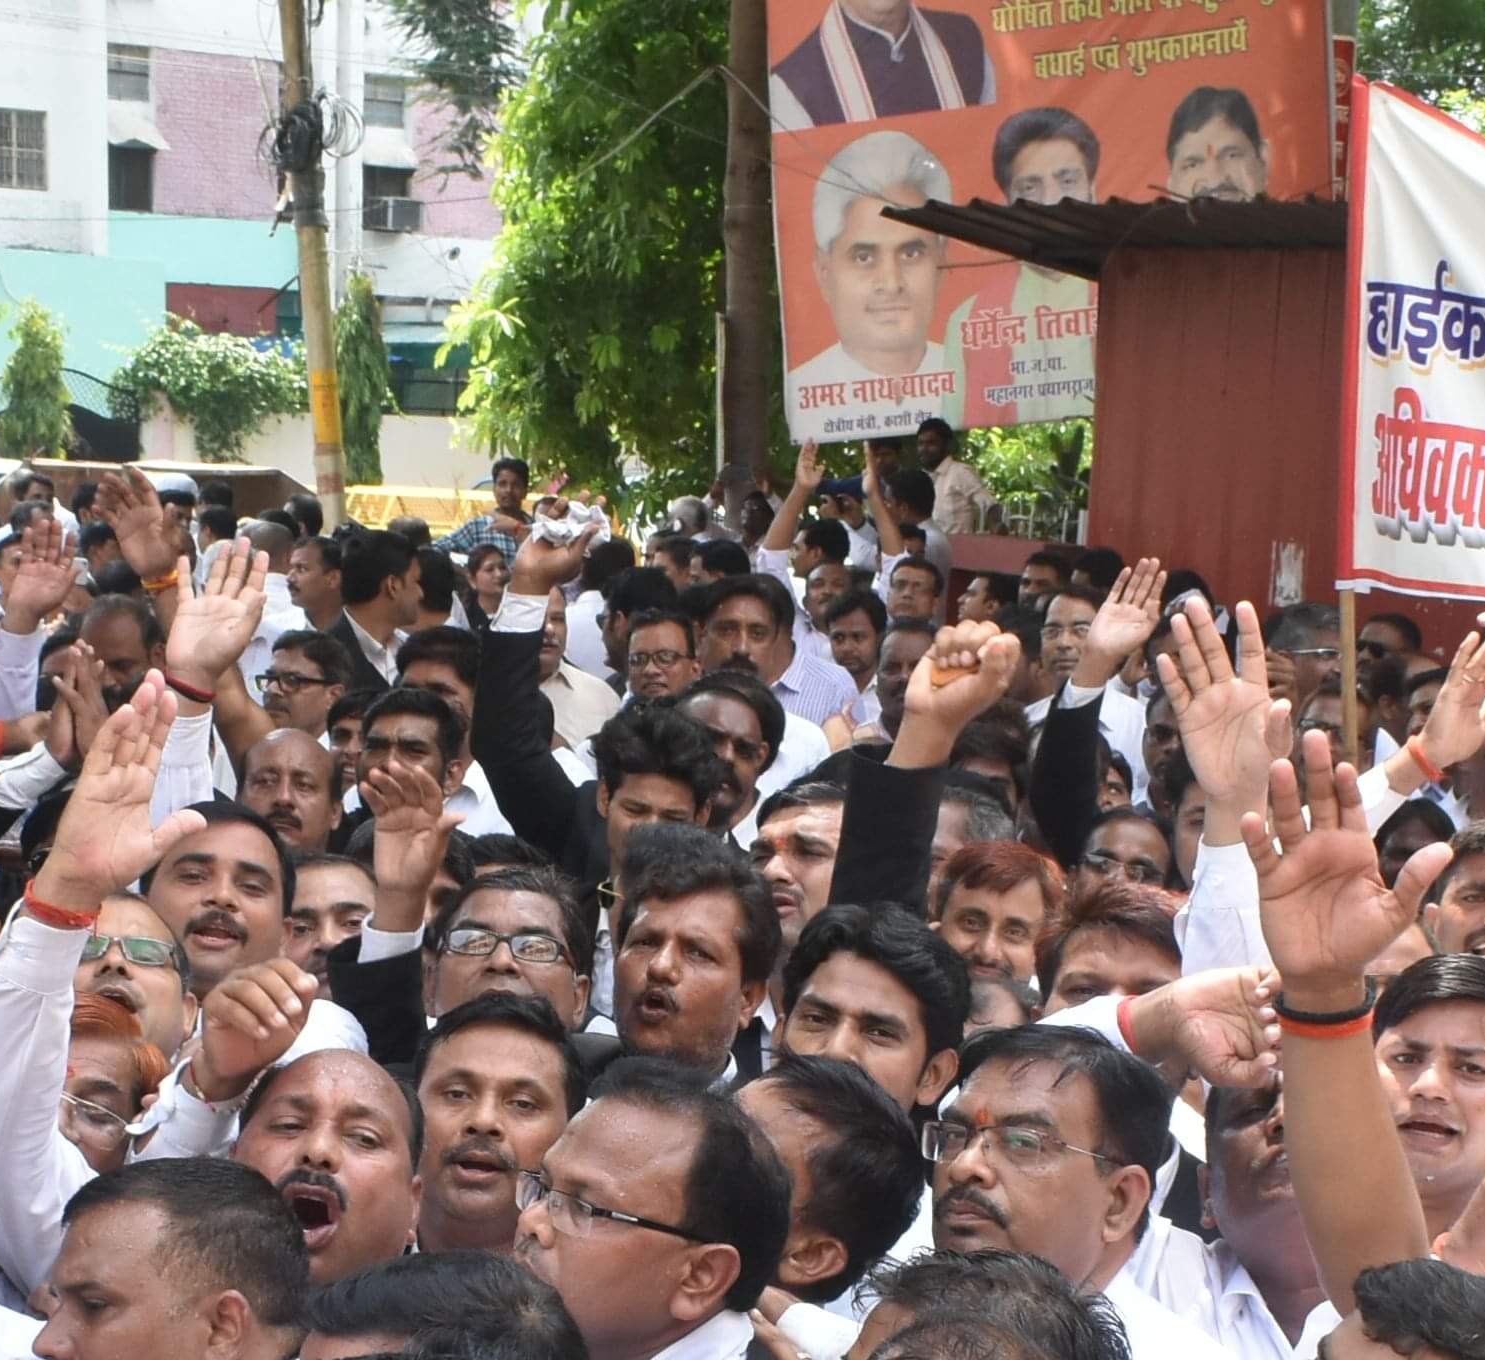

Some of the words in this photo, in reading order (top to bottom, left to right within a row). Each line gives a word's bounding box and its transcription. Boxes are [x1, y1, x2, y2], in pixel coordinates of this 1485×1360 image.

[1033, 41, 1086, 79] बधाई
[1091, 36, 1121, 71] एवं
[797, 382, 847, 411] अमर
[851, 377, 895, 404] नाथ
[899, 371, 956, 399] यादव
